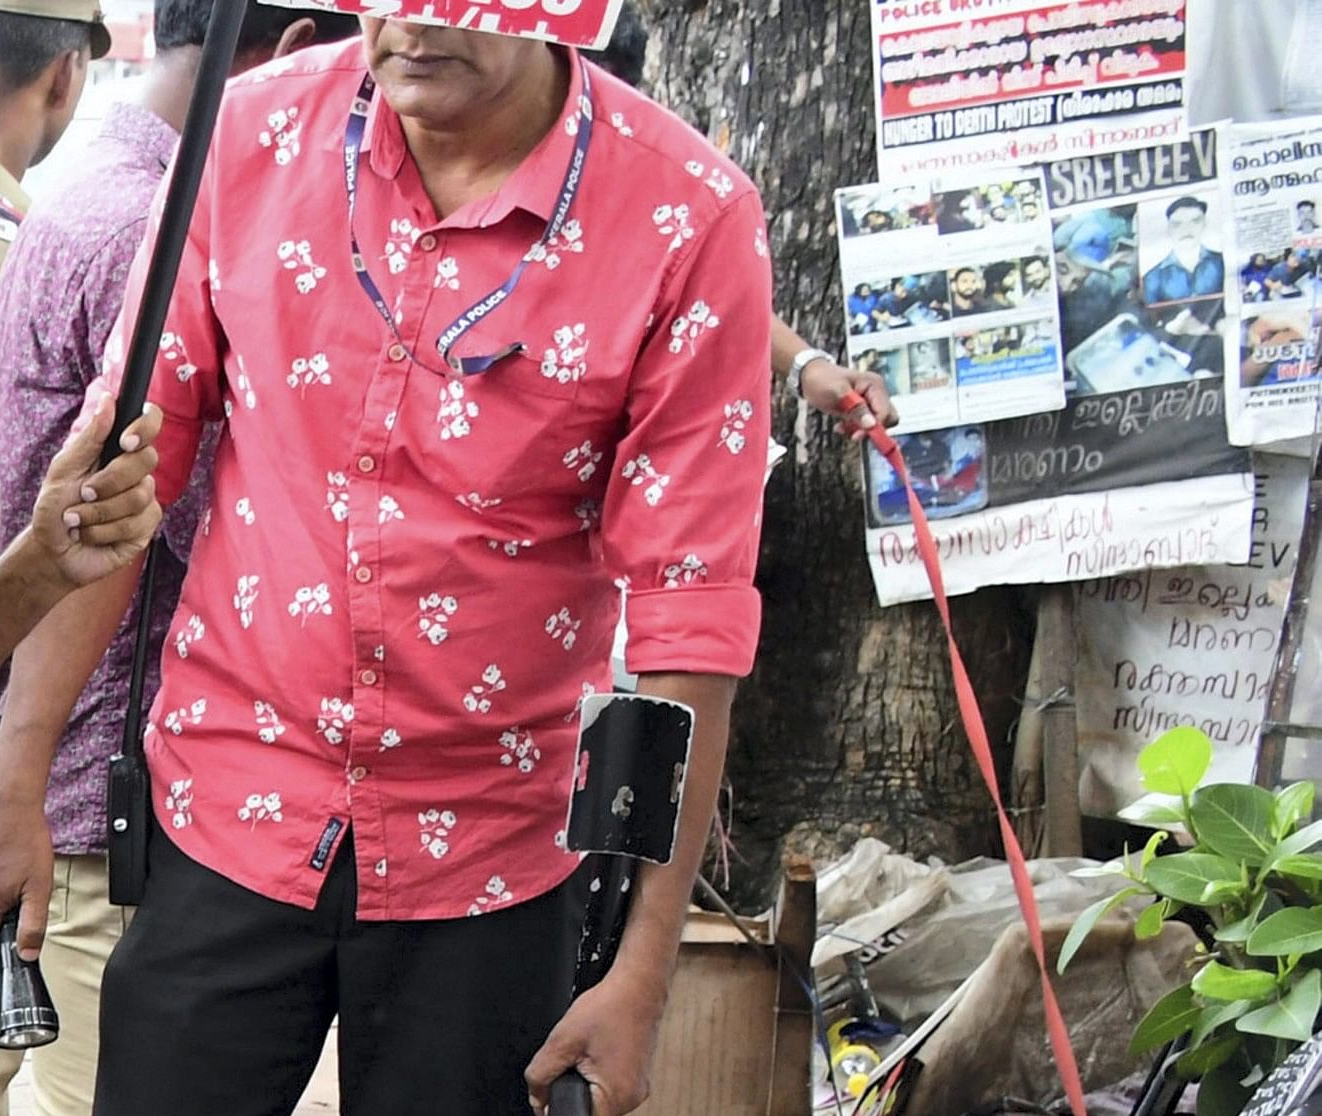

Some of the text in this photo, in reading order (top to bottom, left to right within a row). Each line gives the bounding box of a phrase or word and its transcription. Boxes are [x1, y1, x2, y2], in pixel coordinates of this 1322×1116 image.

[881, 1, 942, 23] POLICE
[567, 147, 585, 192] POLICE
[468, 289, 507, 321] POLICE
